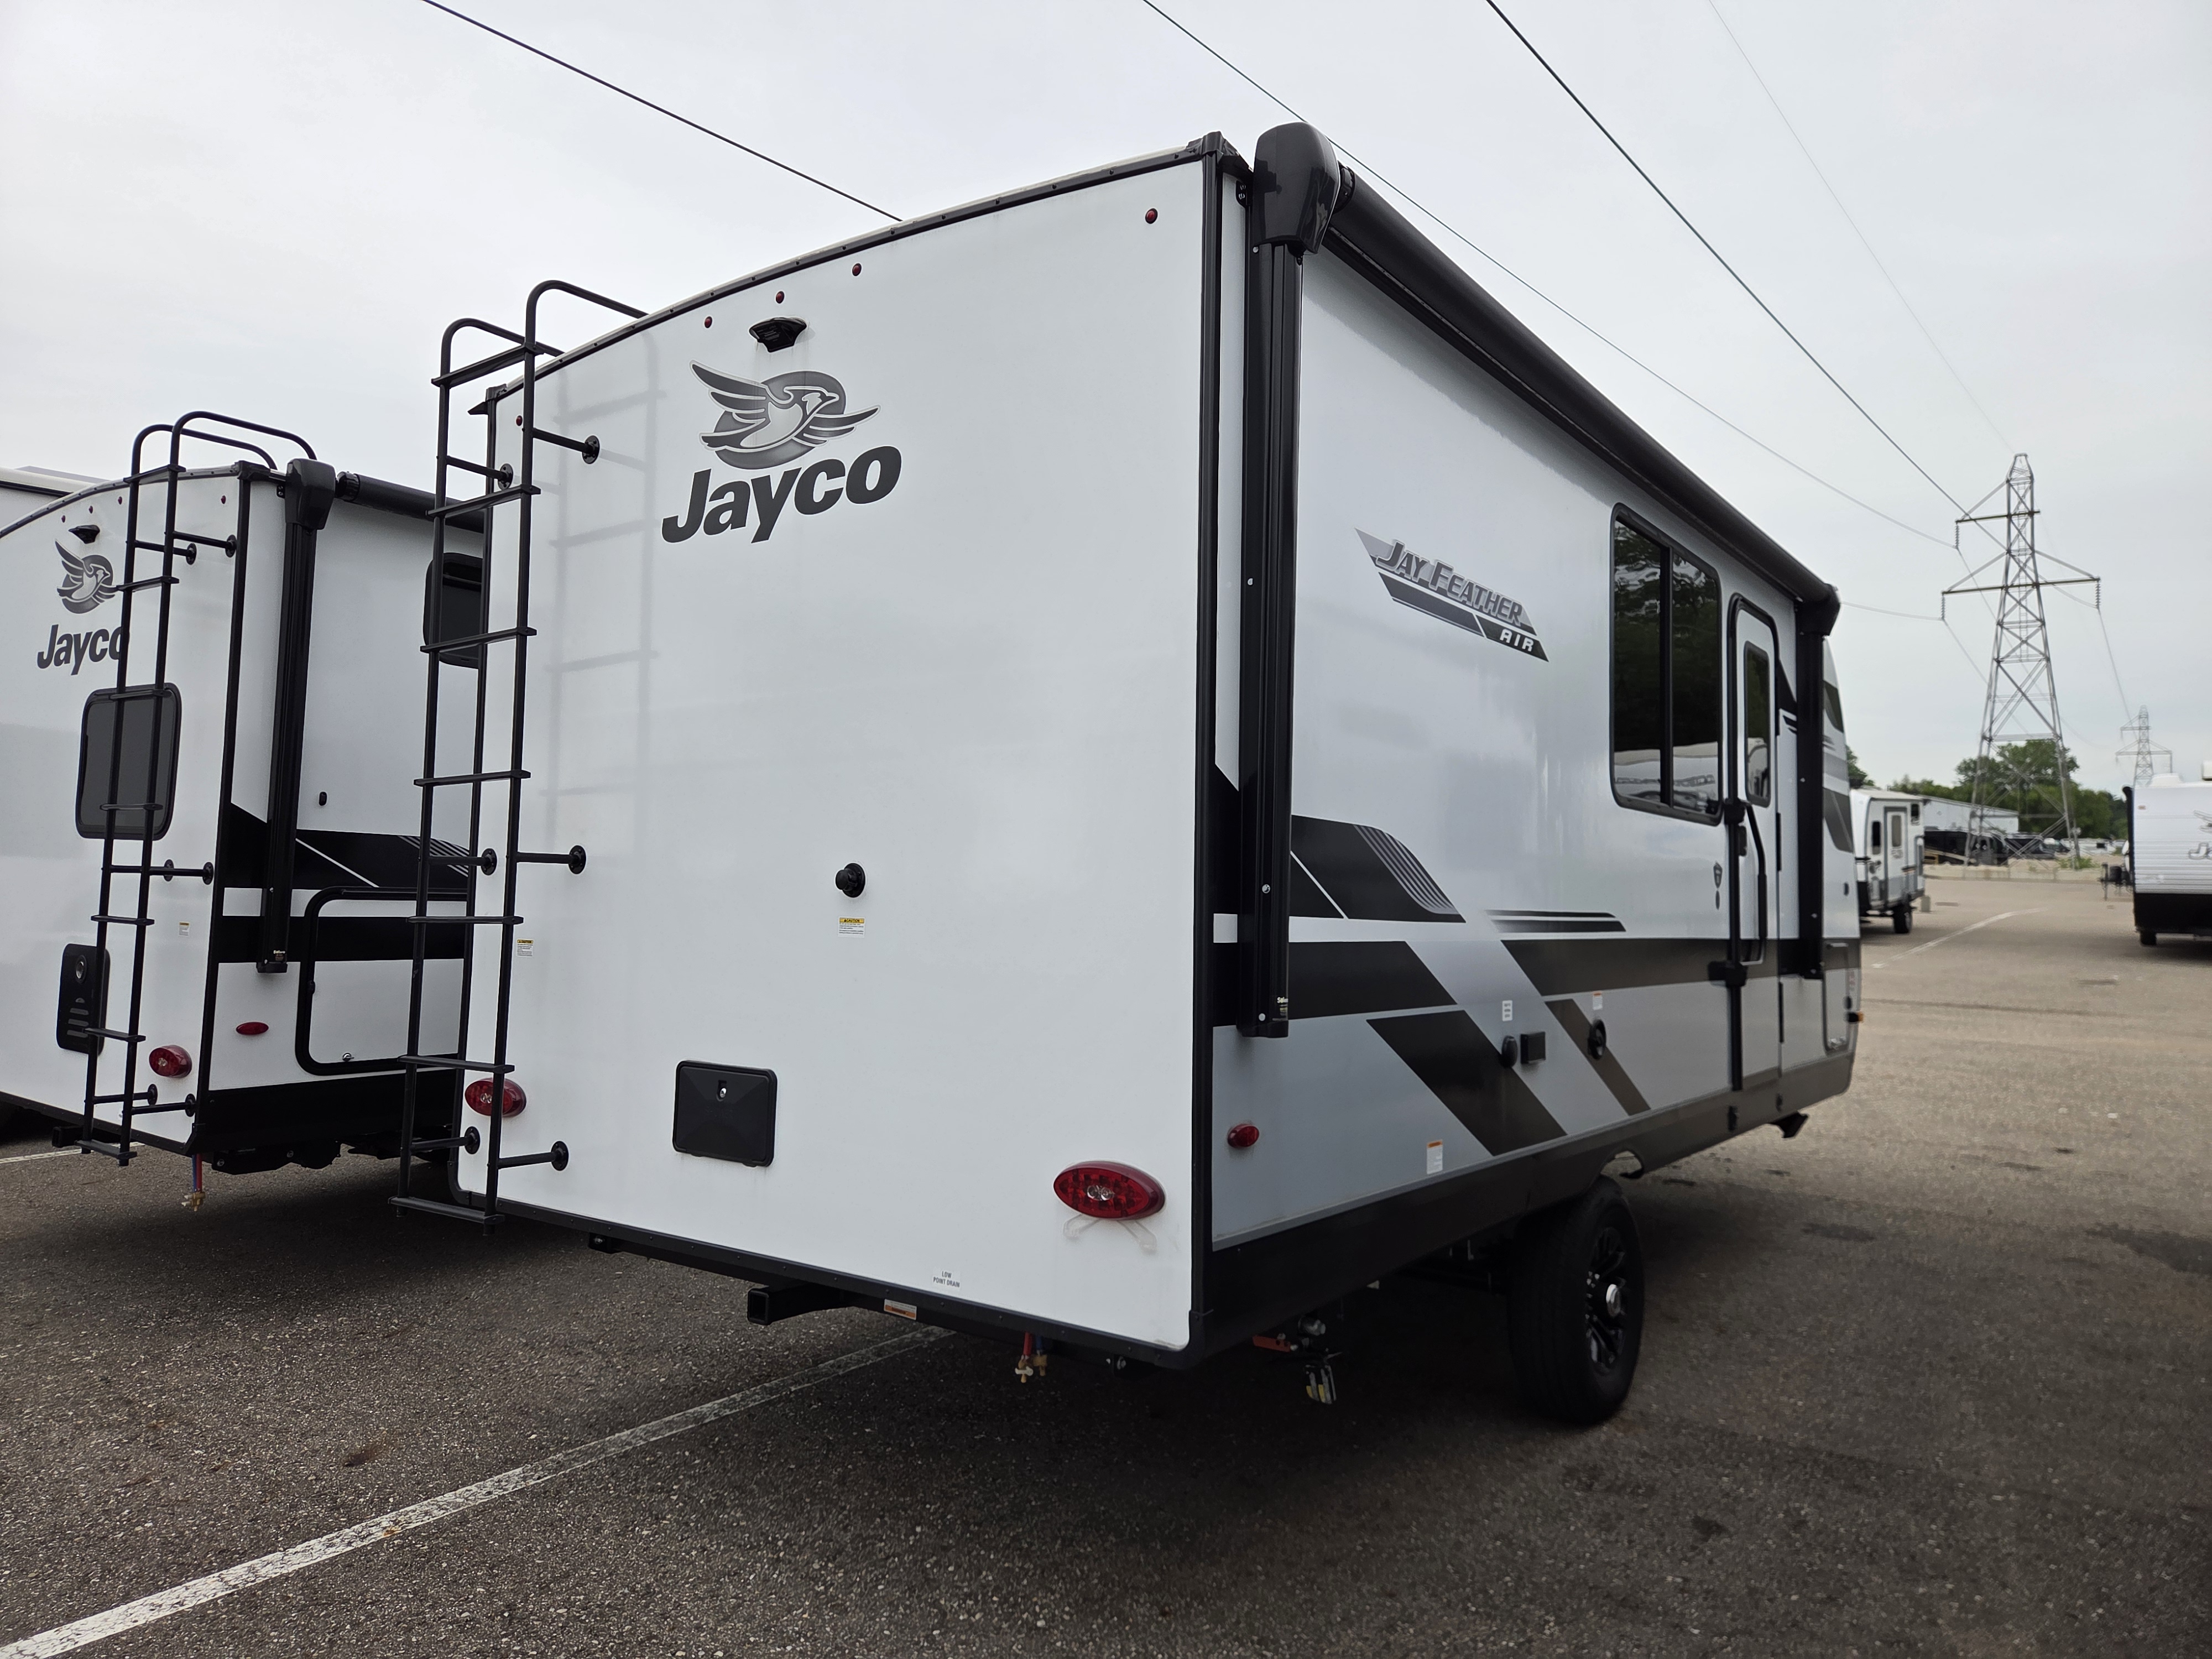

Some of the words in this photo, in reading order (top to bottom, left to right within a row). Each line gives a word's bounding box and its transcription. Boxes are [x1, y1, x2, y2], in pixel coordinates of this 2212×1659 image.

[661, 446, 902, 544] Jayco
[1376, 541, 1430, 582] JAY
[1429, 560, 1523, 625] FEATHER
[1499, 628, 1534, 652] AIR
[933, 1276, 946, 1285] POINT
[946, 1279, 960, 1287] DRAIN
